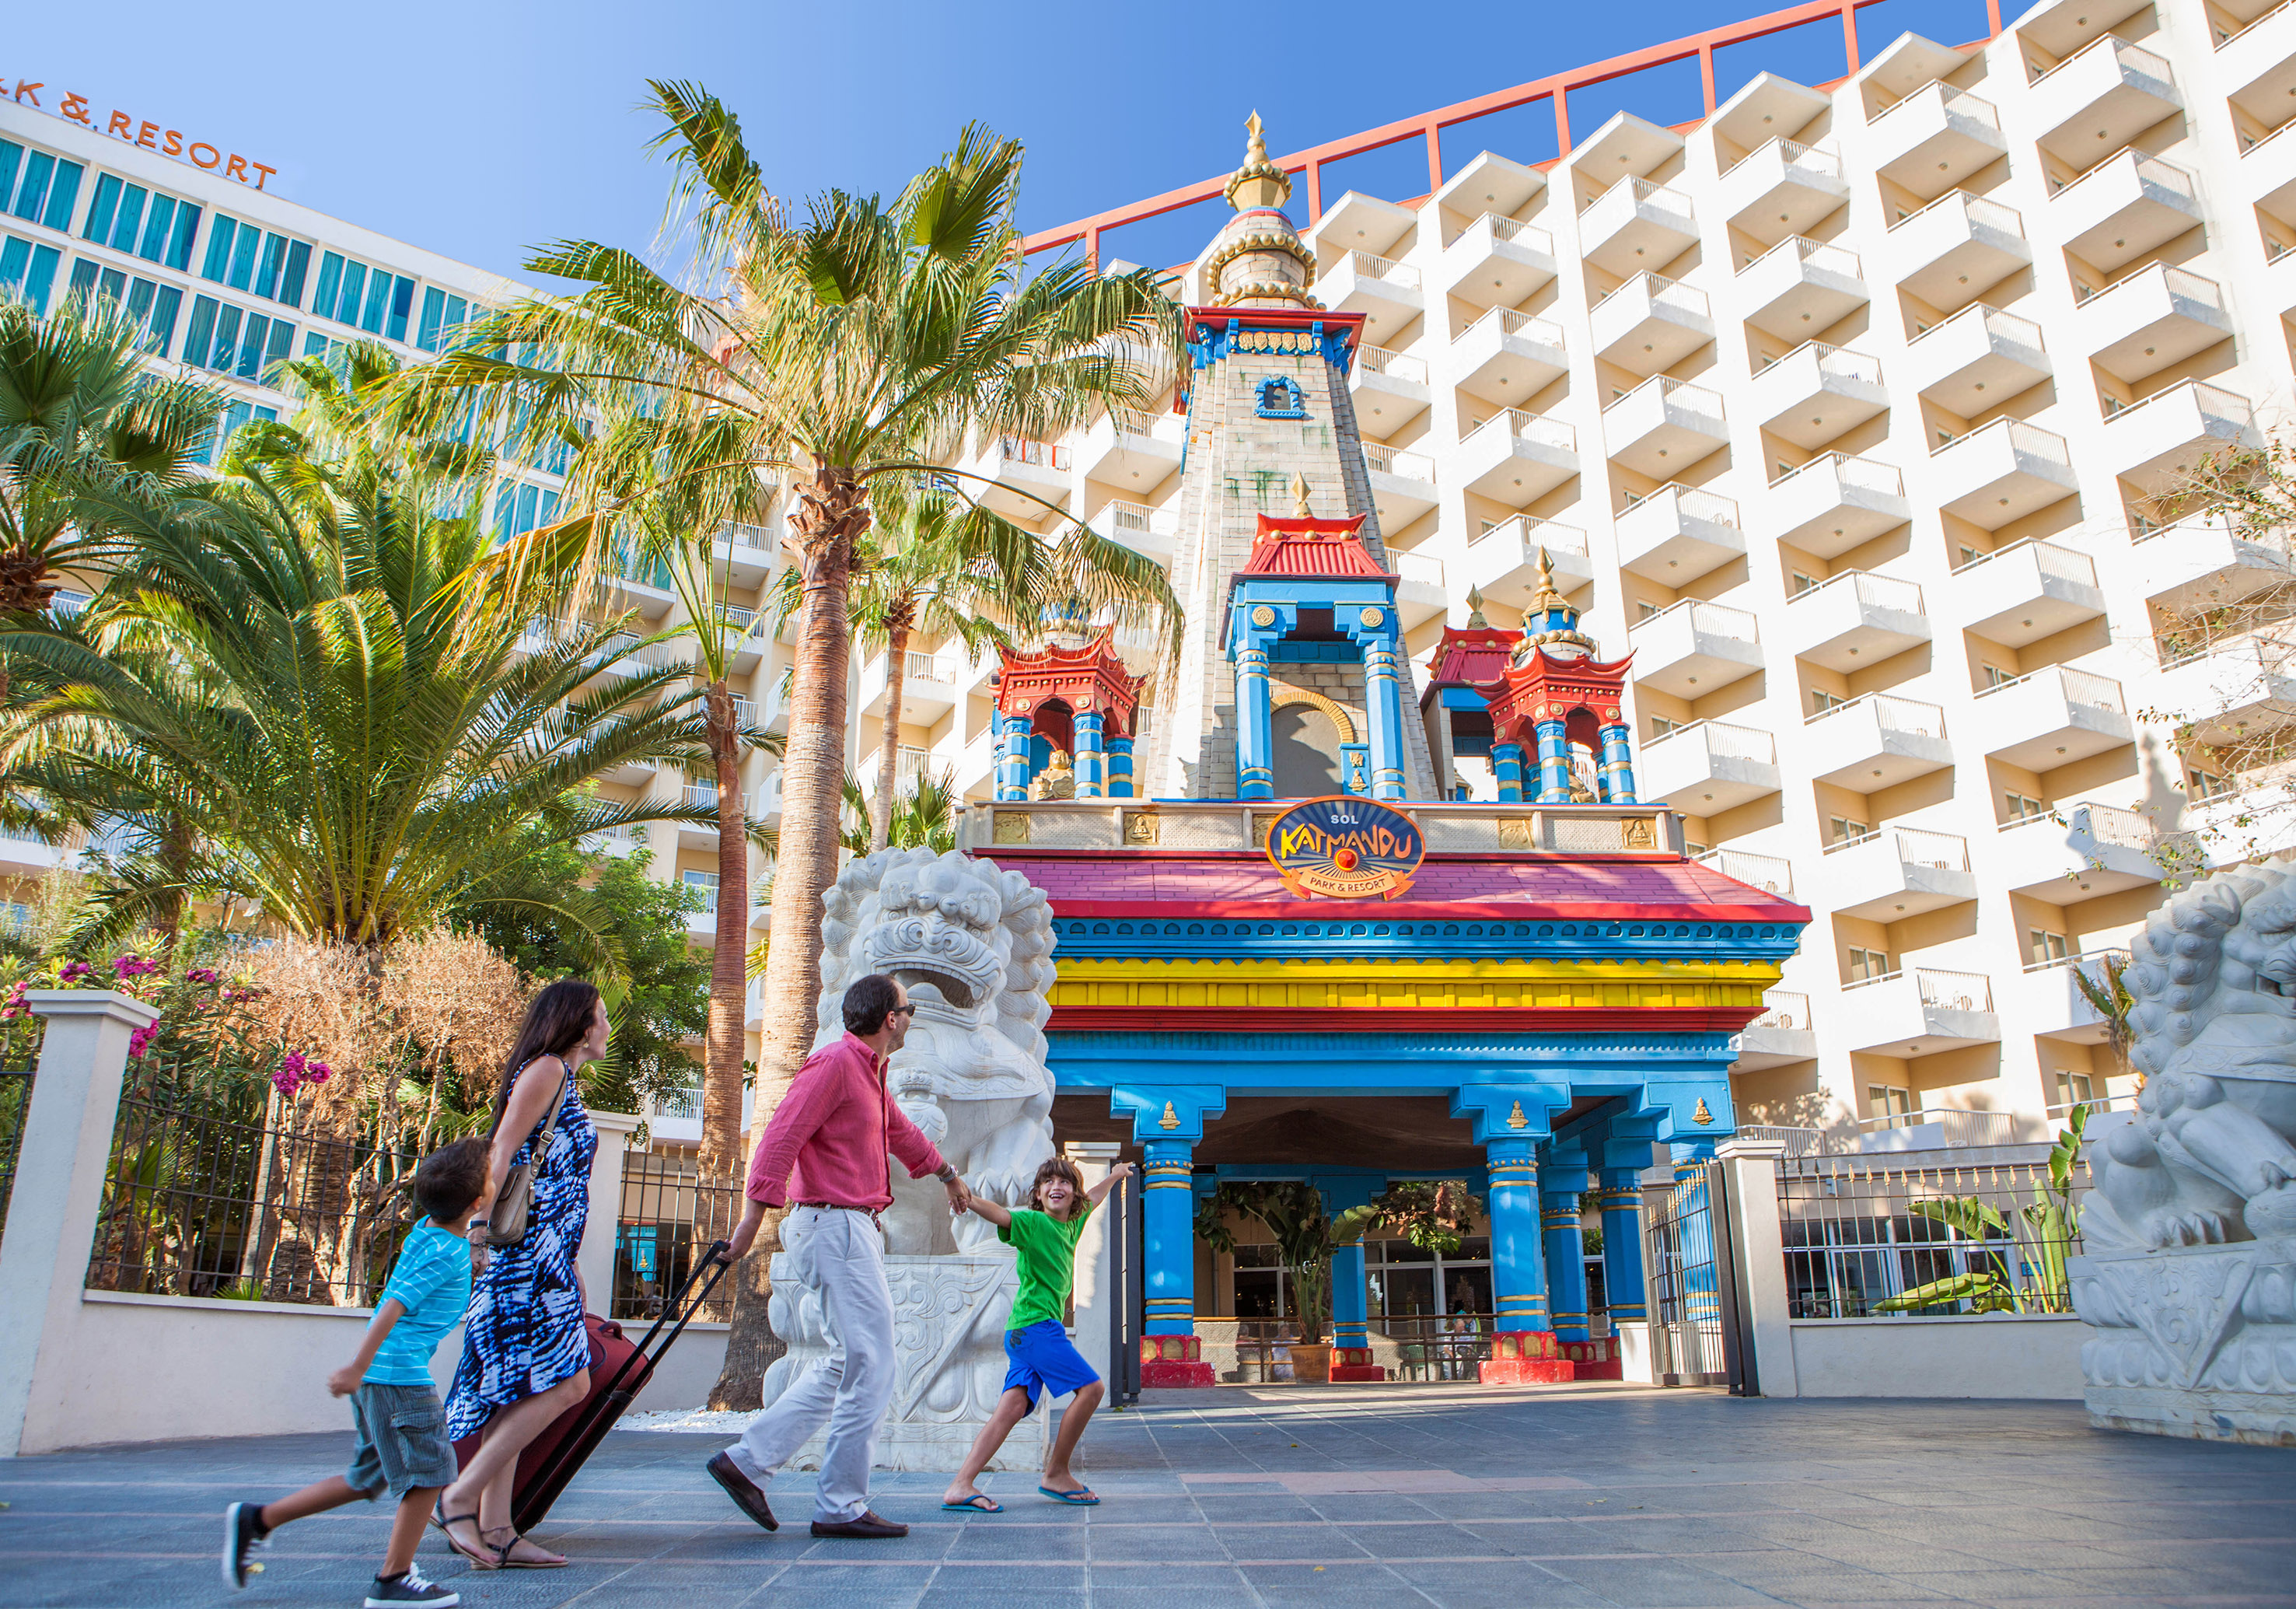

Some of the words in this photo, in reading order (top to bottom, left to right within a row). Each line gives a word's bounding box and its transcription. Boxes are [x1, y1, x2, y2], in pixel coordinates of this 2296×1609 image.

[60, 90, 91, 124] &
[108, 109, 277, 190] RESORT
[1330, 814, 1359, 824] SOL
[1281, 823, 1411, 859] KATMANDU
[1310, 876, 1336, 890] PARK
[1337, 883, 1346, 892] &
[1347, 878, 1386, 892] RESORT
